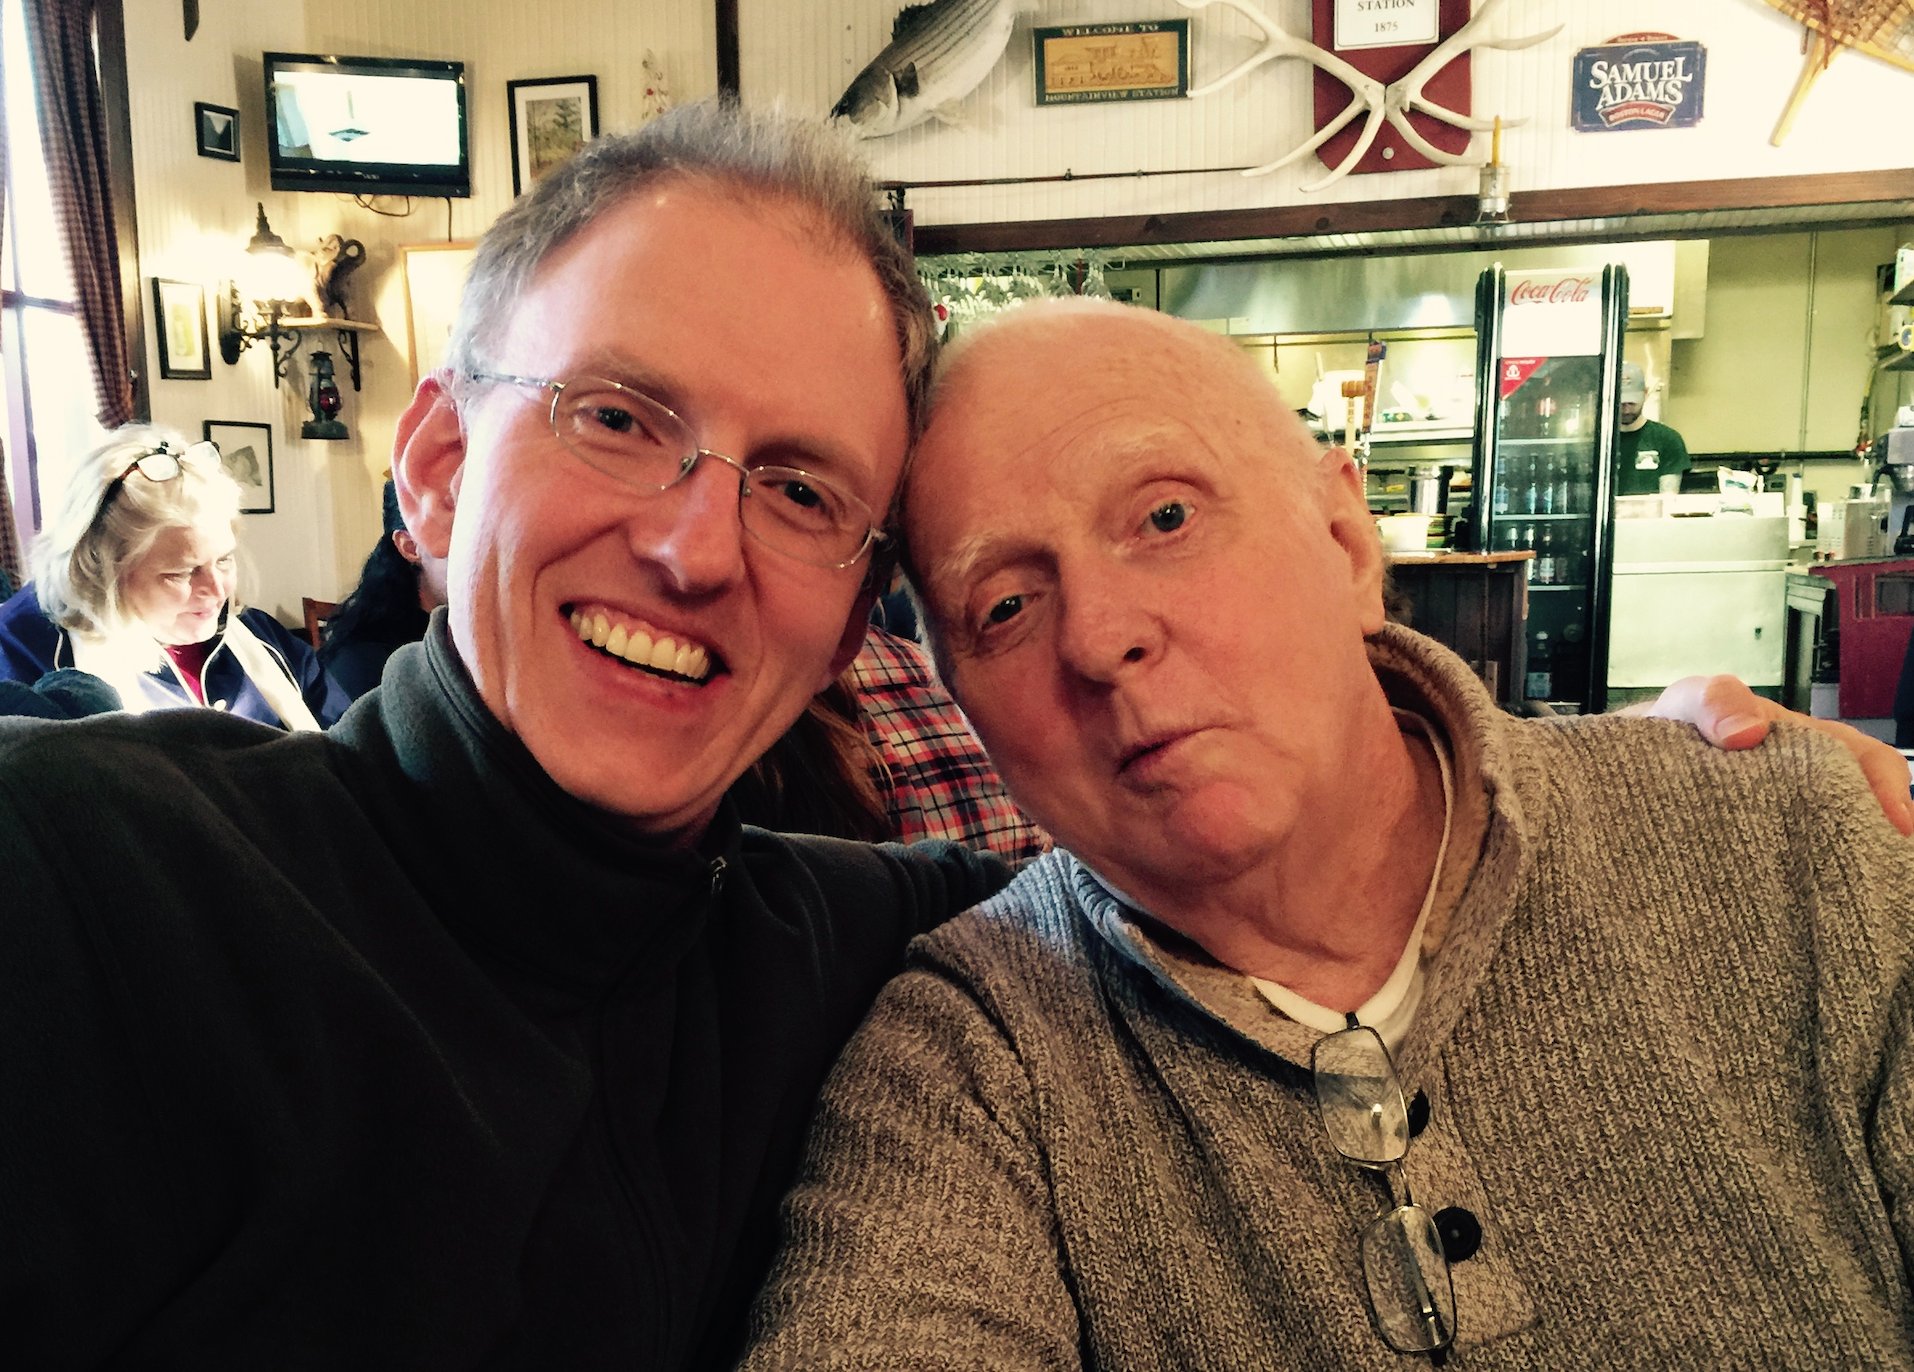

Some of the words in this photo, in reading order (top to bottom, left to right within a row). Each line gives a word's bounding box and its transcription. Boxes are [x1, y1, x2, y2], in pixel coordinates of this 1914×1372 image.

[1357, 0, 1416, 11] STATION
[1062, 24, 1135, 36] WELCOME
[1139, 23, 1160, 32] TO
[1374, 21, 1399, 33] 1875
[1589, 56, 1693, 89] SAMUEL
[1131, 88, 1179, 98] STATION
[1595, 80, 1684, 111] ADAMS
